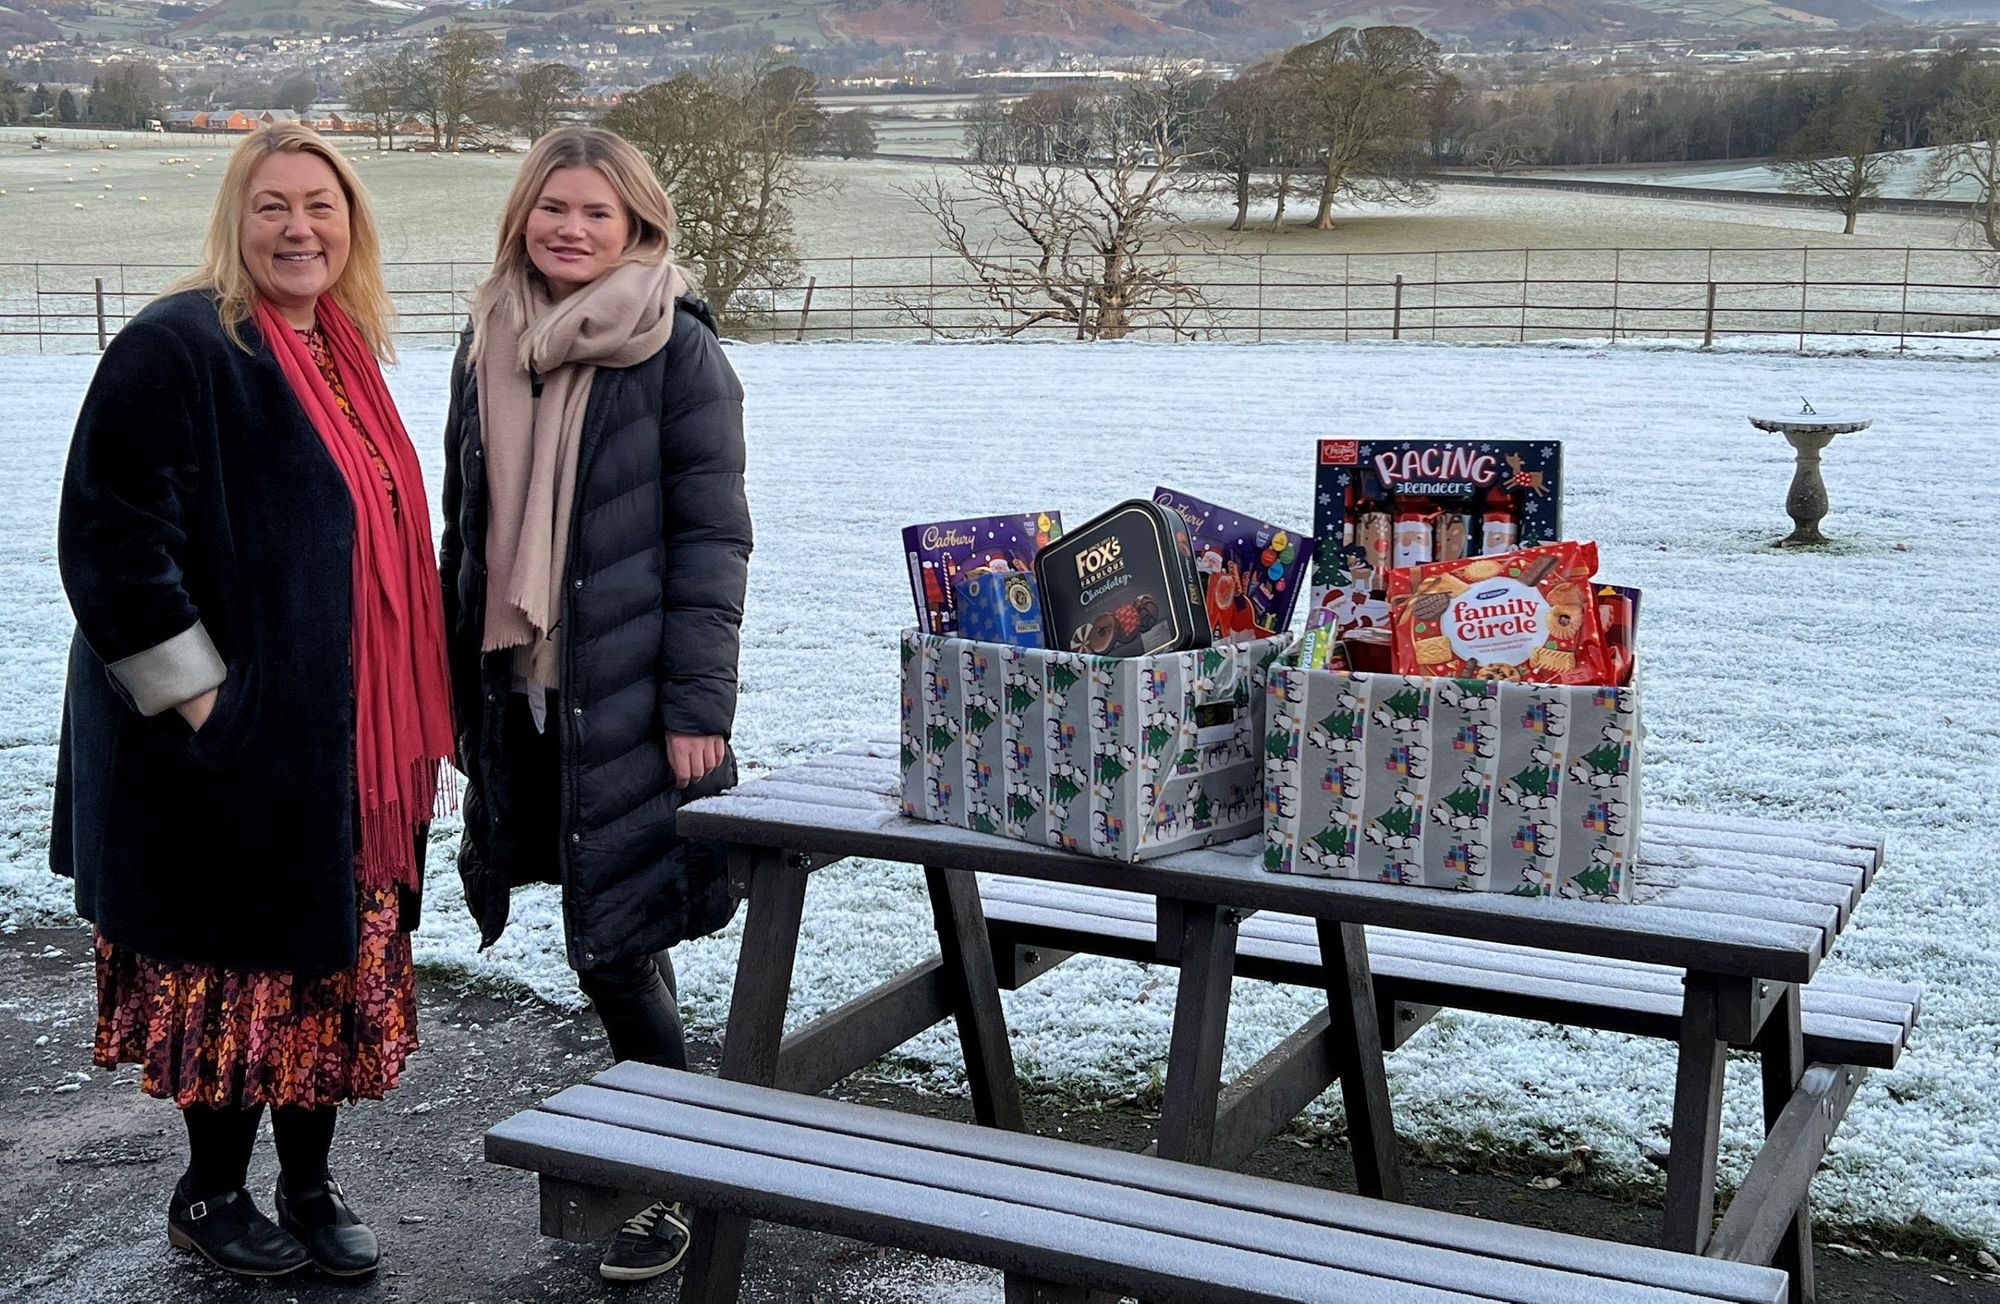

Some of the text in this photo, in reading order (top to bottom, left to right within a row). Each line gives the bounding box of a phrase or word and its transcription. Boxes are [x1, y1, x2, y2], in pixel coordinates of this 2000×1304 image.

[1375, 447, 1496, 485] RACING
[1405, 482, 1465, 494] Reindeer
[922, 526, 975, 550] Cadbury
[1081, 560, 1124, 588] FABULOUS
[1080, 574, 1132, 606] Chocolatey
[1453, 598, 1540, 623] family
[1457, 616, 1538, 641] Circle
